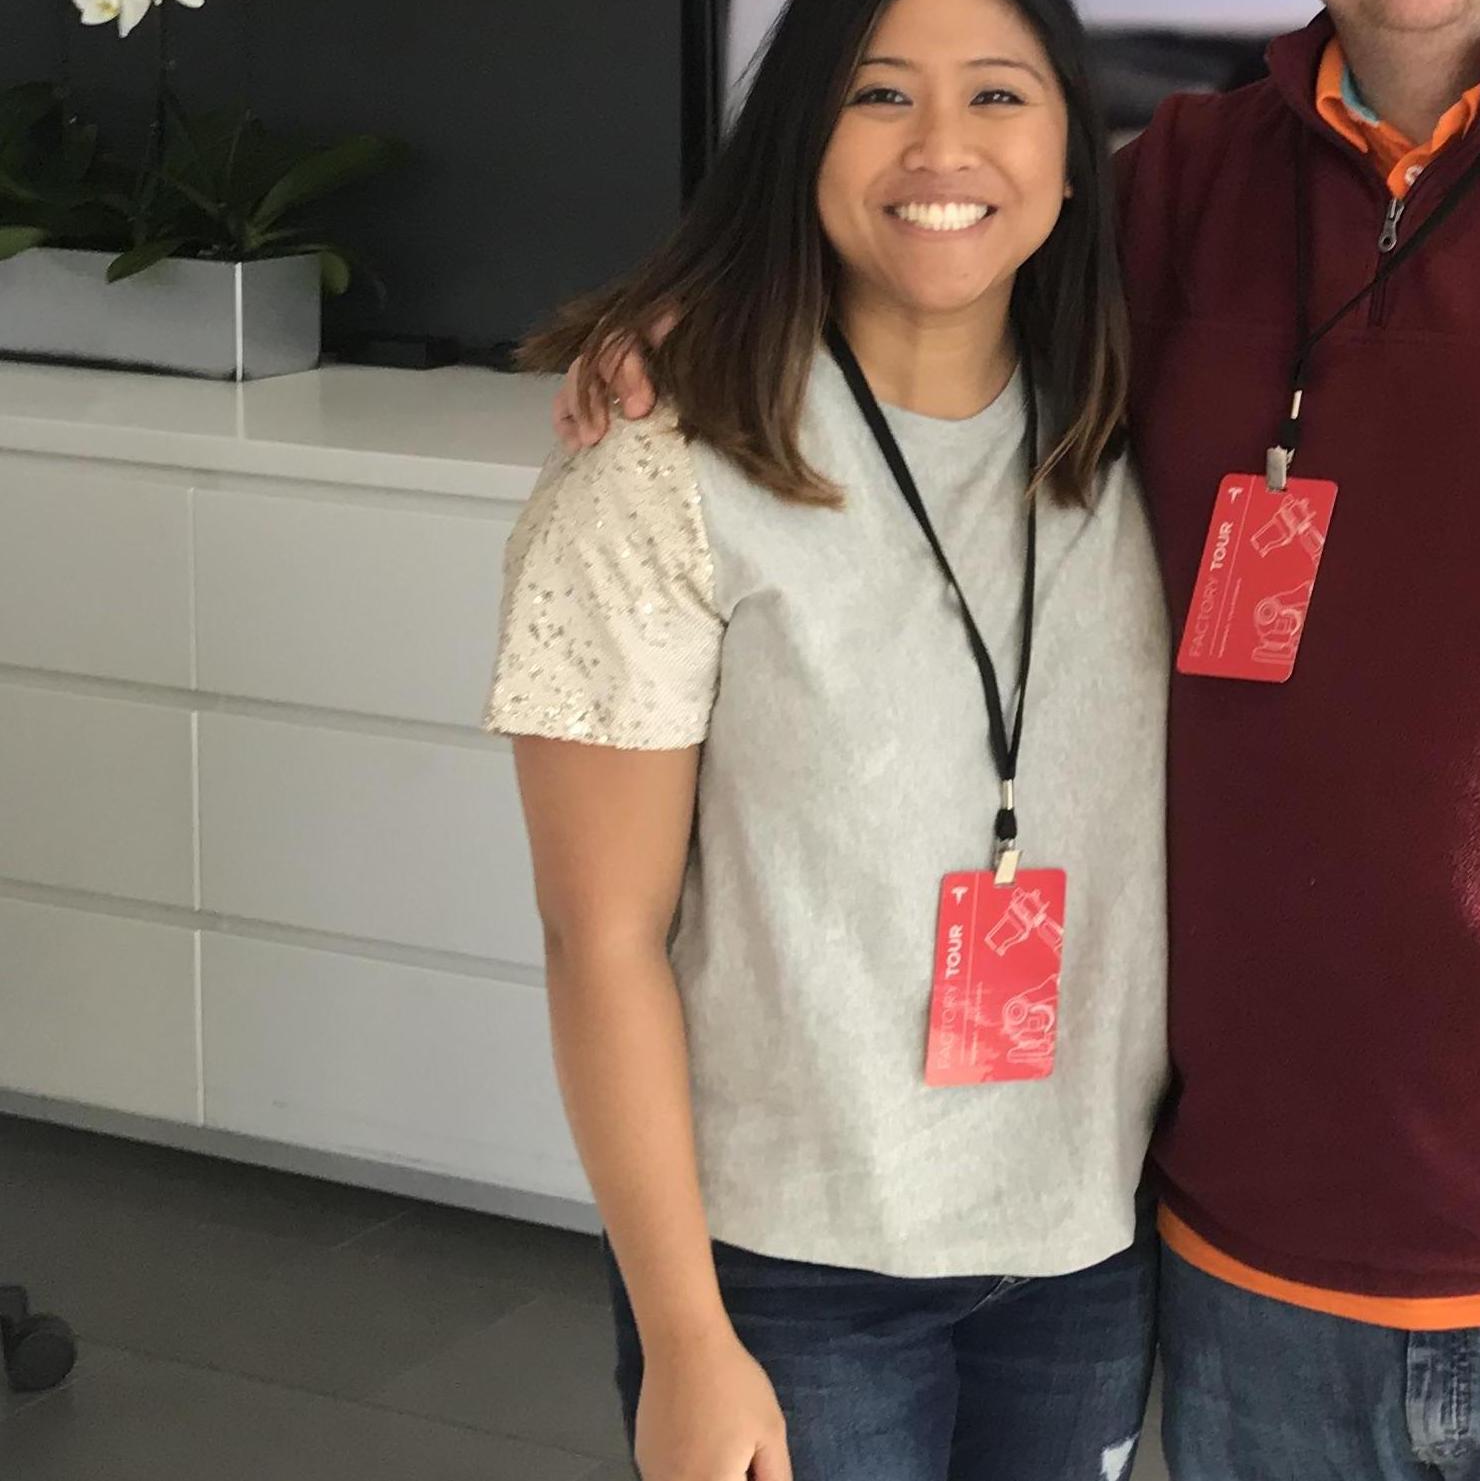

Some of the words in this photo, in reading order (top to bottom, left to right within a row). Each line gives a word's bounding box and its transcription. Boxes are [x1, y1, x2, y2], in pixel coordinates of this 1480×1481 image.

[1190, 577, 1218, 656] FACTORY
[1210, 521, 1233, 571] TOUR
[945, 925, 963, 979] TOUR
